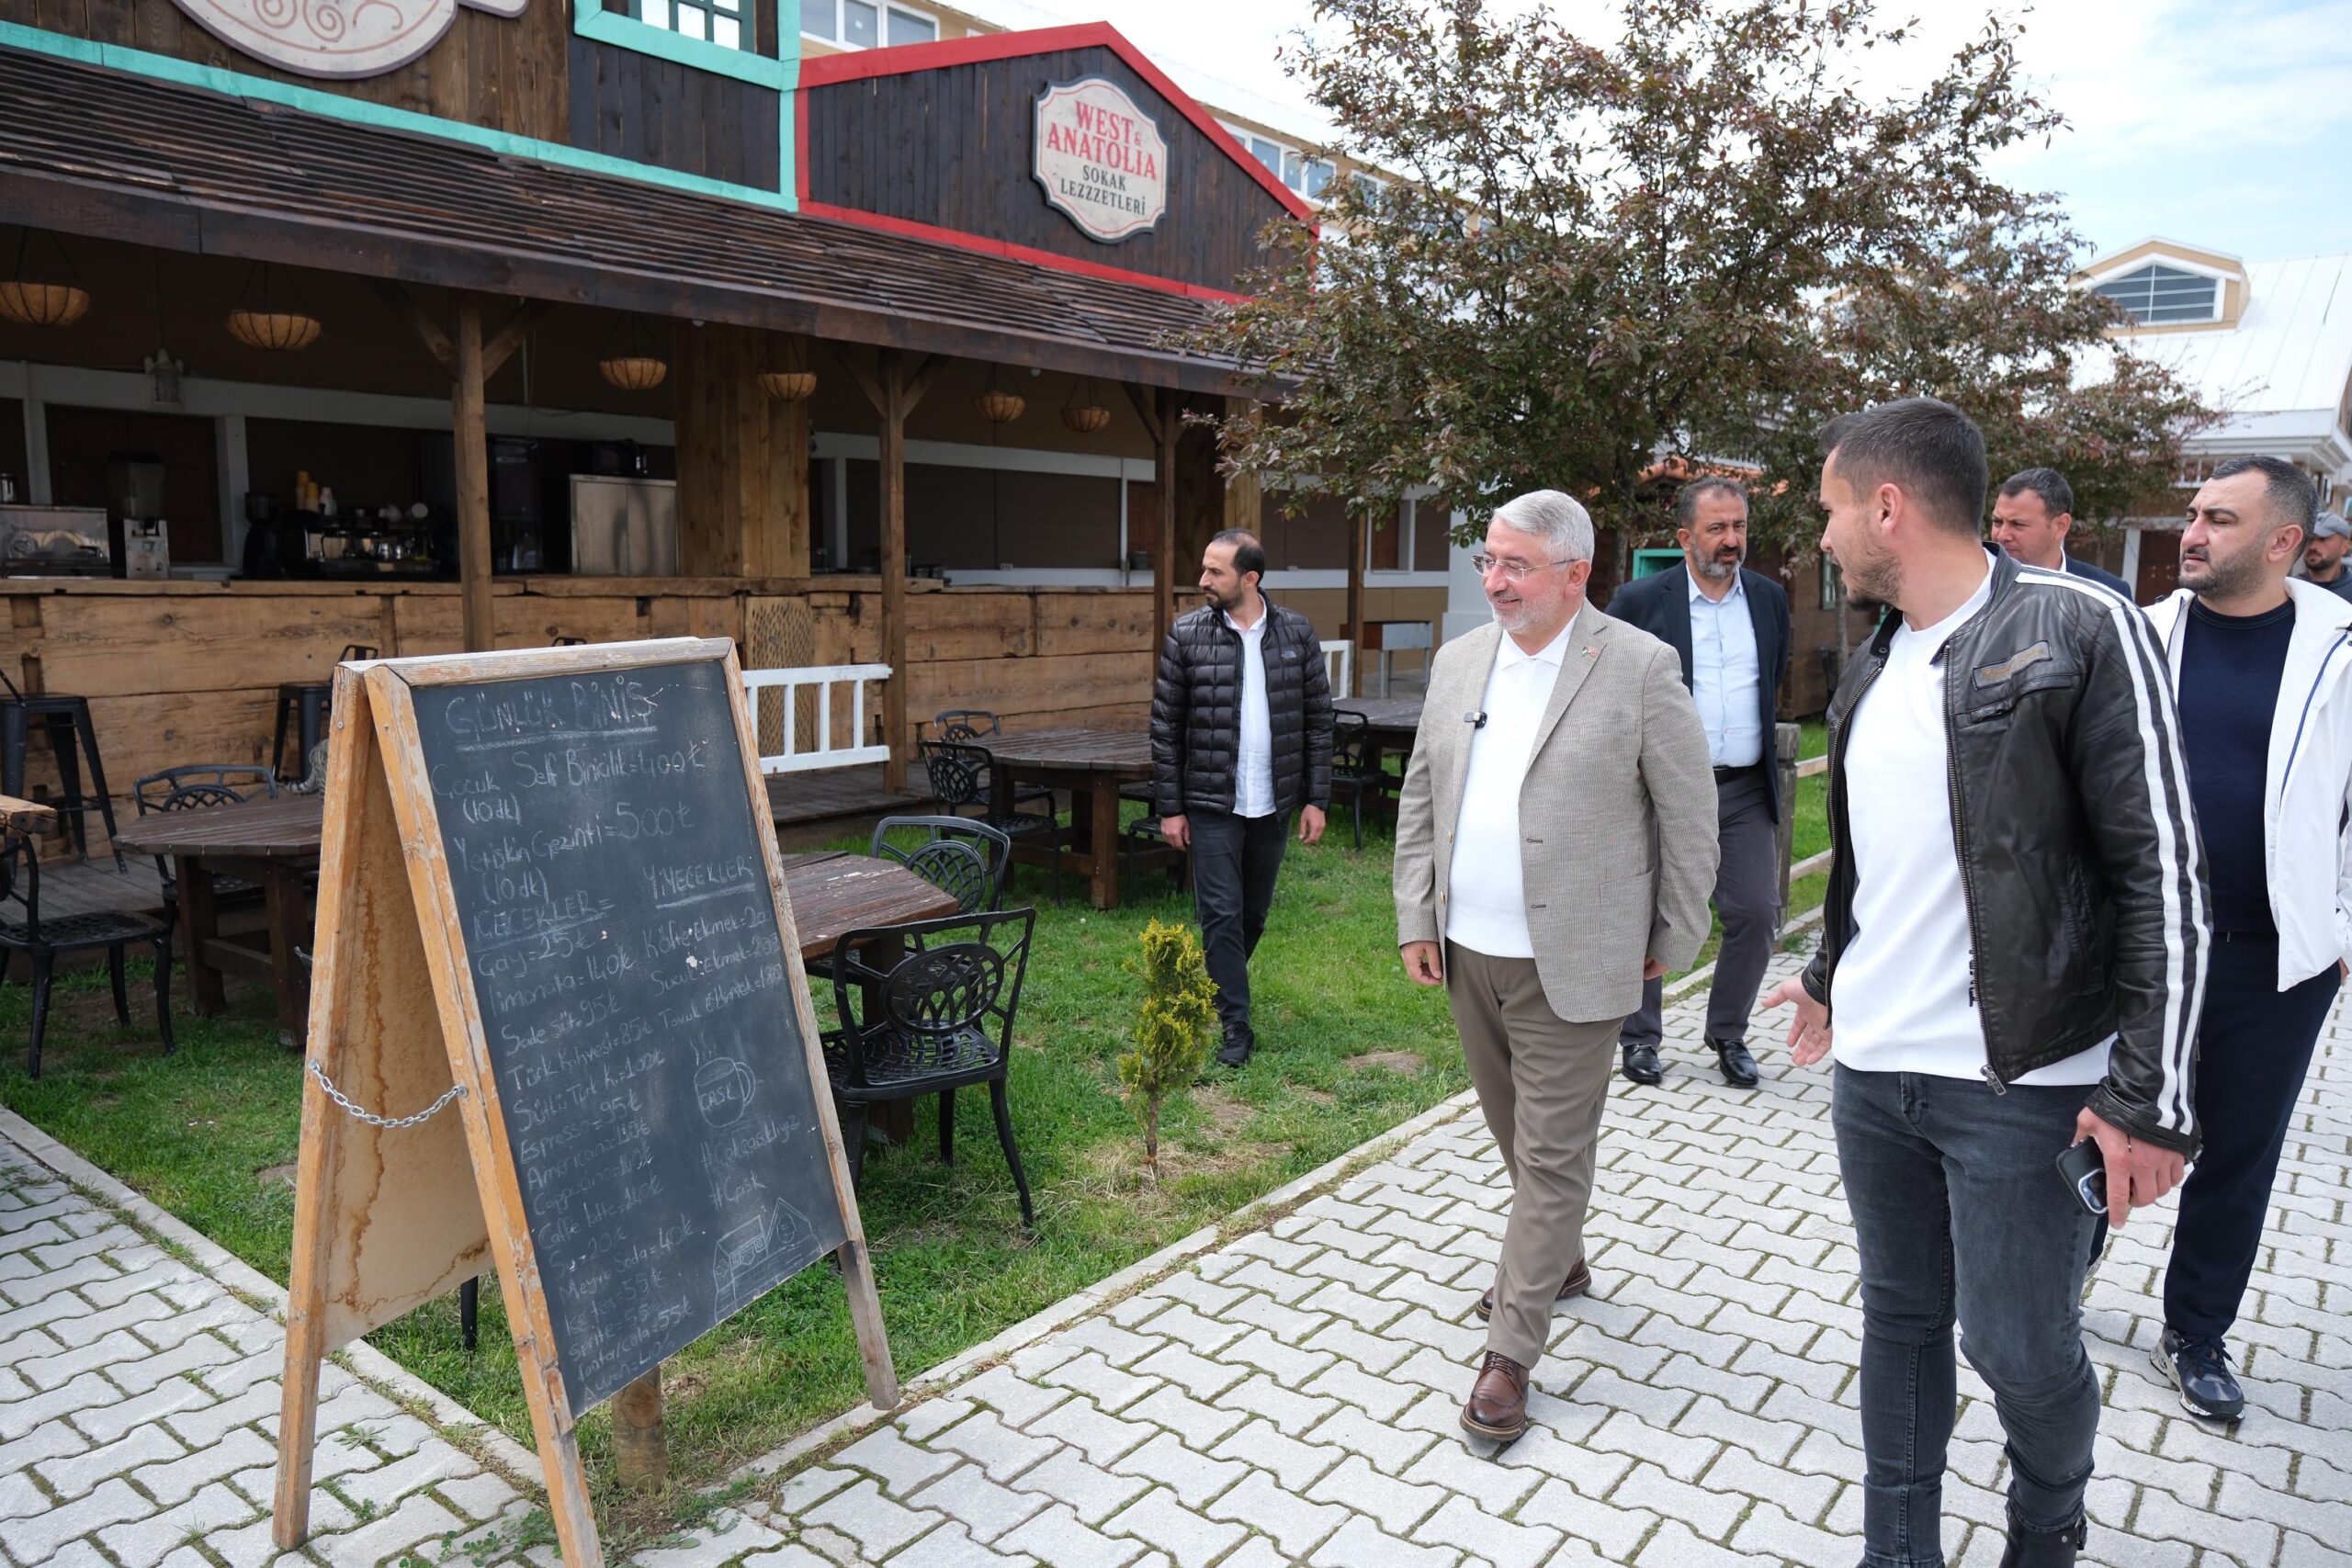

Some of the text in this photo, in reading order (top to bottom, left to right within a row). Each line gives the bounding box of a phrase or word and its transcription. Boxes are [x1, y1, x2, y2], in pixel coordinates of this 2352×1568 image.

[1074, 100, 1143, 146] WEST &
[1046, 122, 1157, 181] ANATOLIA
[1060, 177, 1147, 216] LEZZZETLERİ
[1082, 164, 1126, 192] SOKAK
